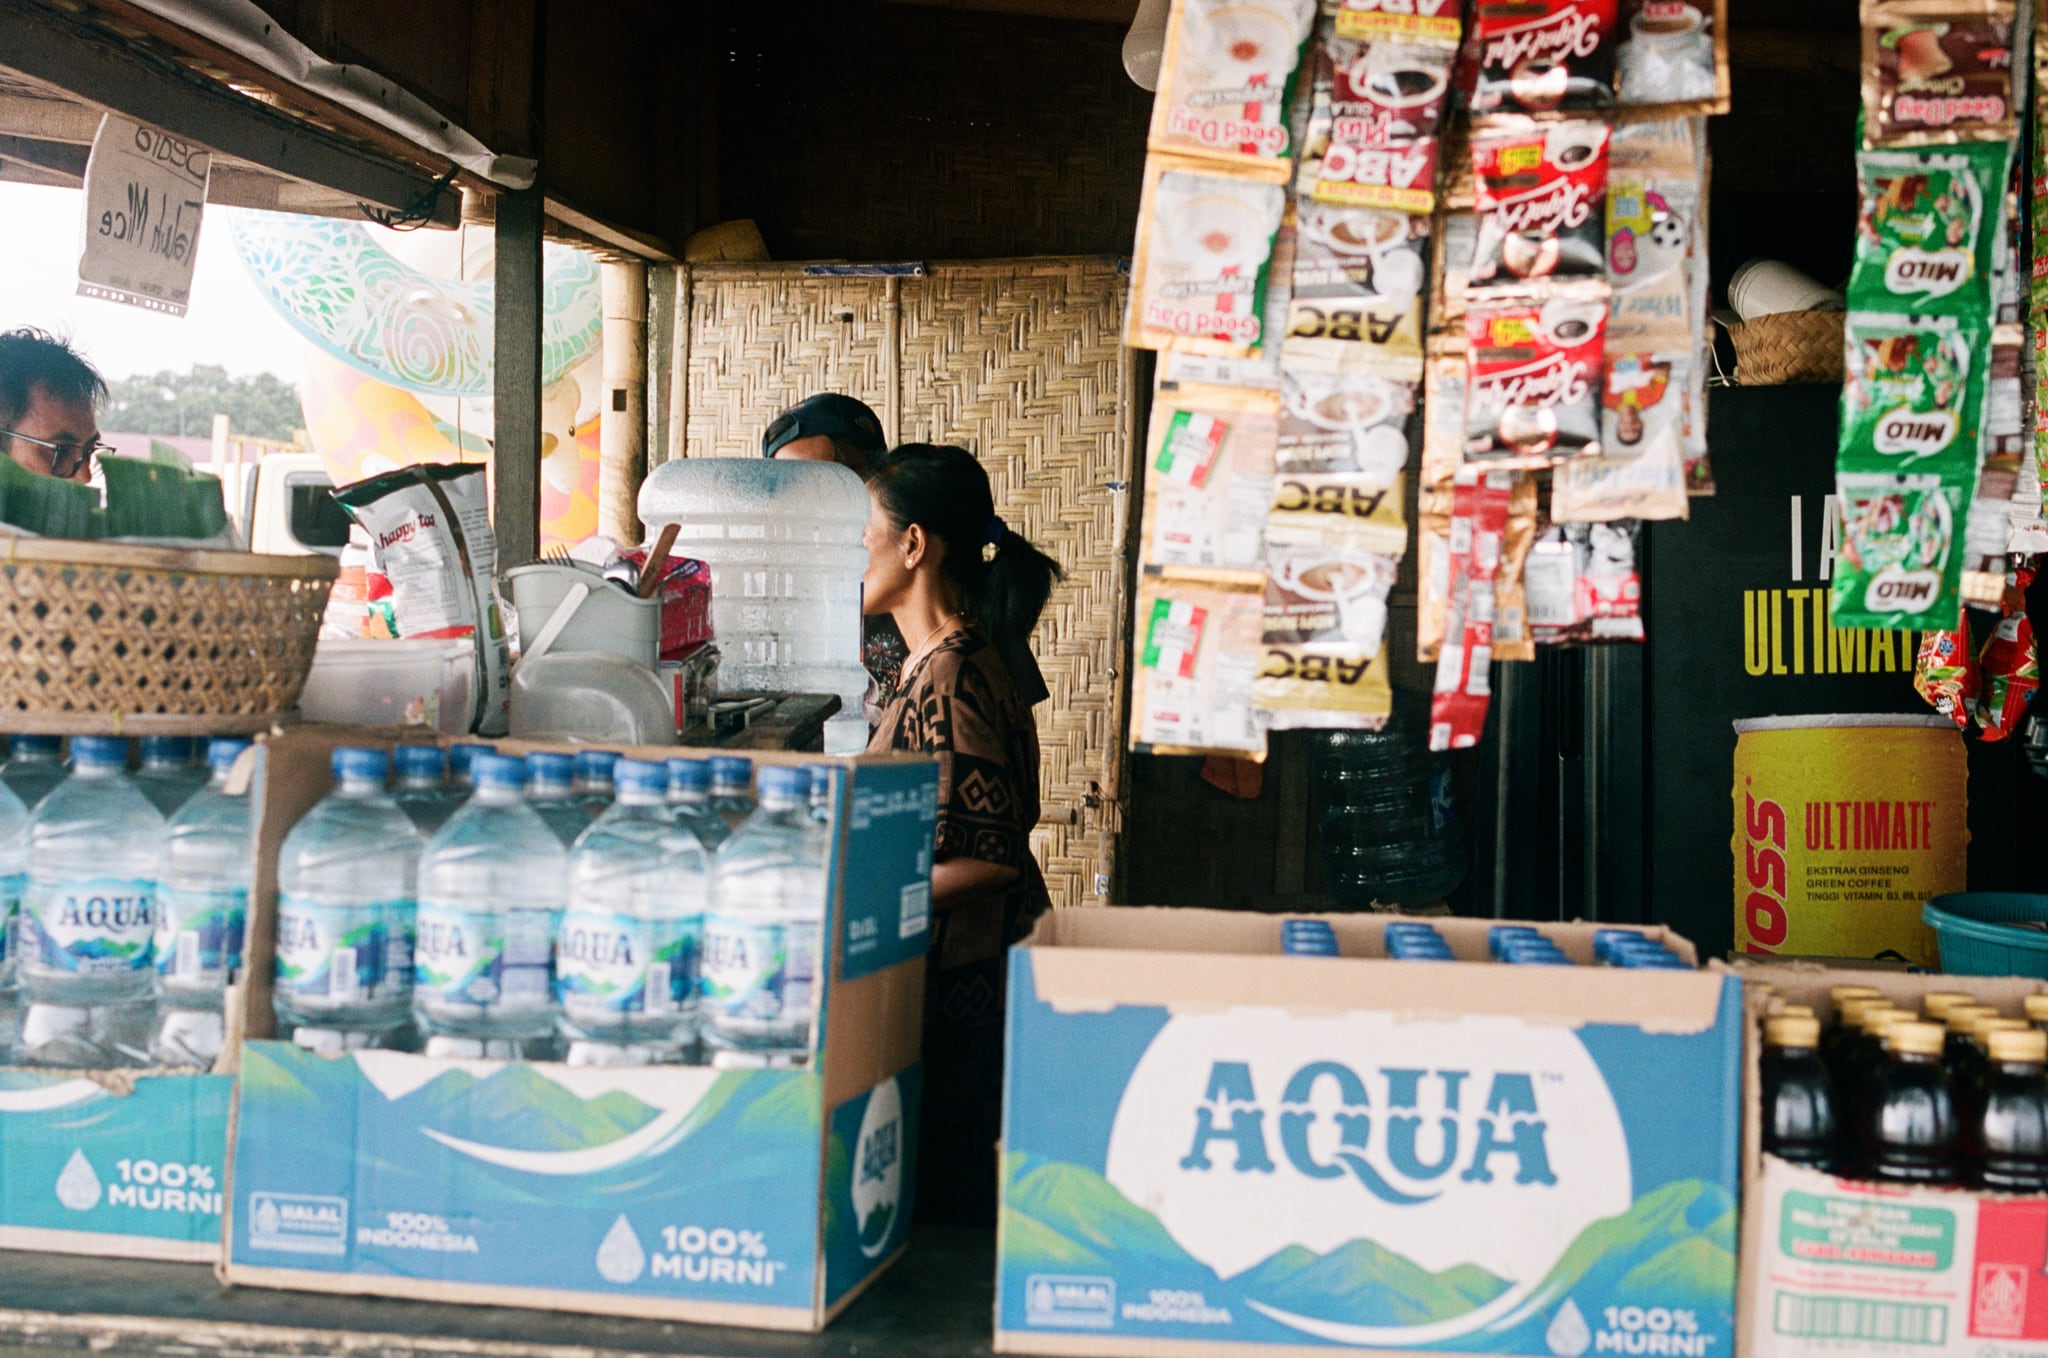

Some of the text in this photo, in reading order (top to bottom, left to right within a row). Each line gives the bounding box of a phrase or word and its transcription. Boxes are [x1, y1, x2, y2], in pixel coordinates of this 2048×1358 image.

[1895, 95, 2004, 125] Good Day
[1171, 107, 1287, 150] Good Day
[1336, 112, 1392, 147] Plus
[1322, 145, 1428, 188] ABC
[1897, 261, 1959, 282] MILO
[1147, 300, 1260, 340] Good Day
[1293, 306, 1404, 344] ABC
[1886, 422, 1945, 442] MILO
[1275, 481, 1386, 517] ABC
[379, 519, 417, 549] happy
[1791, 495, 1802, 581] I
[1877, 580, 1931, 600] MILO
[1744, 588, 1912, 676] ULTIMA
[1263, 649, 1371, 686] ABC
[1805, 801, 1932, 850] ULTIMATE
[1806, 866, 1909, 876] EKSTRAK GINSENG
[1806, 879, 1892, 889] GREEN COFFEE
[1806, 891, 1840, 901] TINGGI
[1844, 891, 1883, 901] VITAMIN
[59, 896, 149, 934] AQUA
[1180, 1060, 1559, 1207] AQUA
[116, 1157, 215, 1190] 100%
[108, 1184, 223, 1216] MURNI
[387, 1211, 449, 1233] 100%
[357, 1228, 479, 1253] INDONESIA
[661, 1223, 768, 1258] 100%
[651, 1252, 776, 1287] MURNI
[1603, 1305, 1699, 1334] 100%
[1595, 1329, 1706, 1357] MURNI
